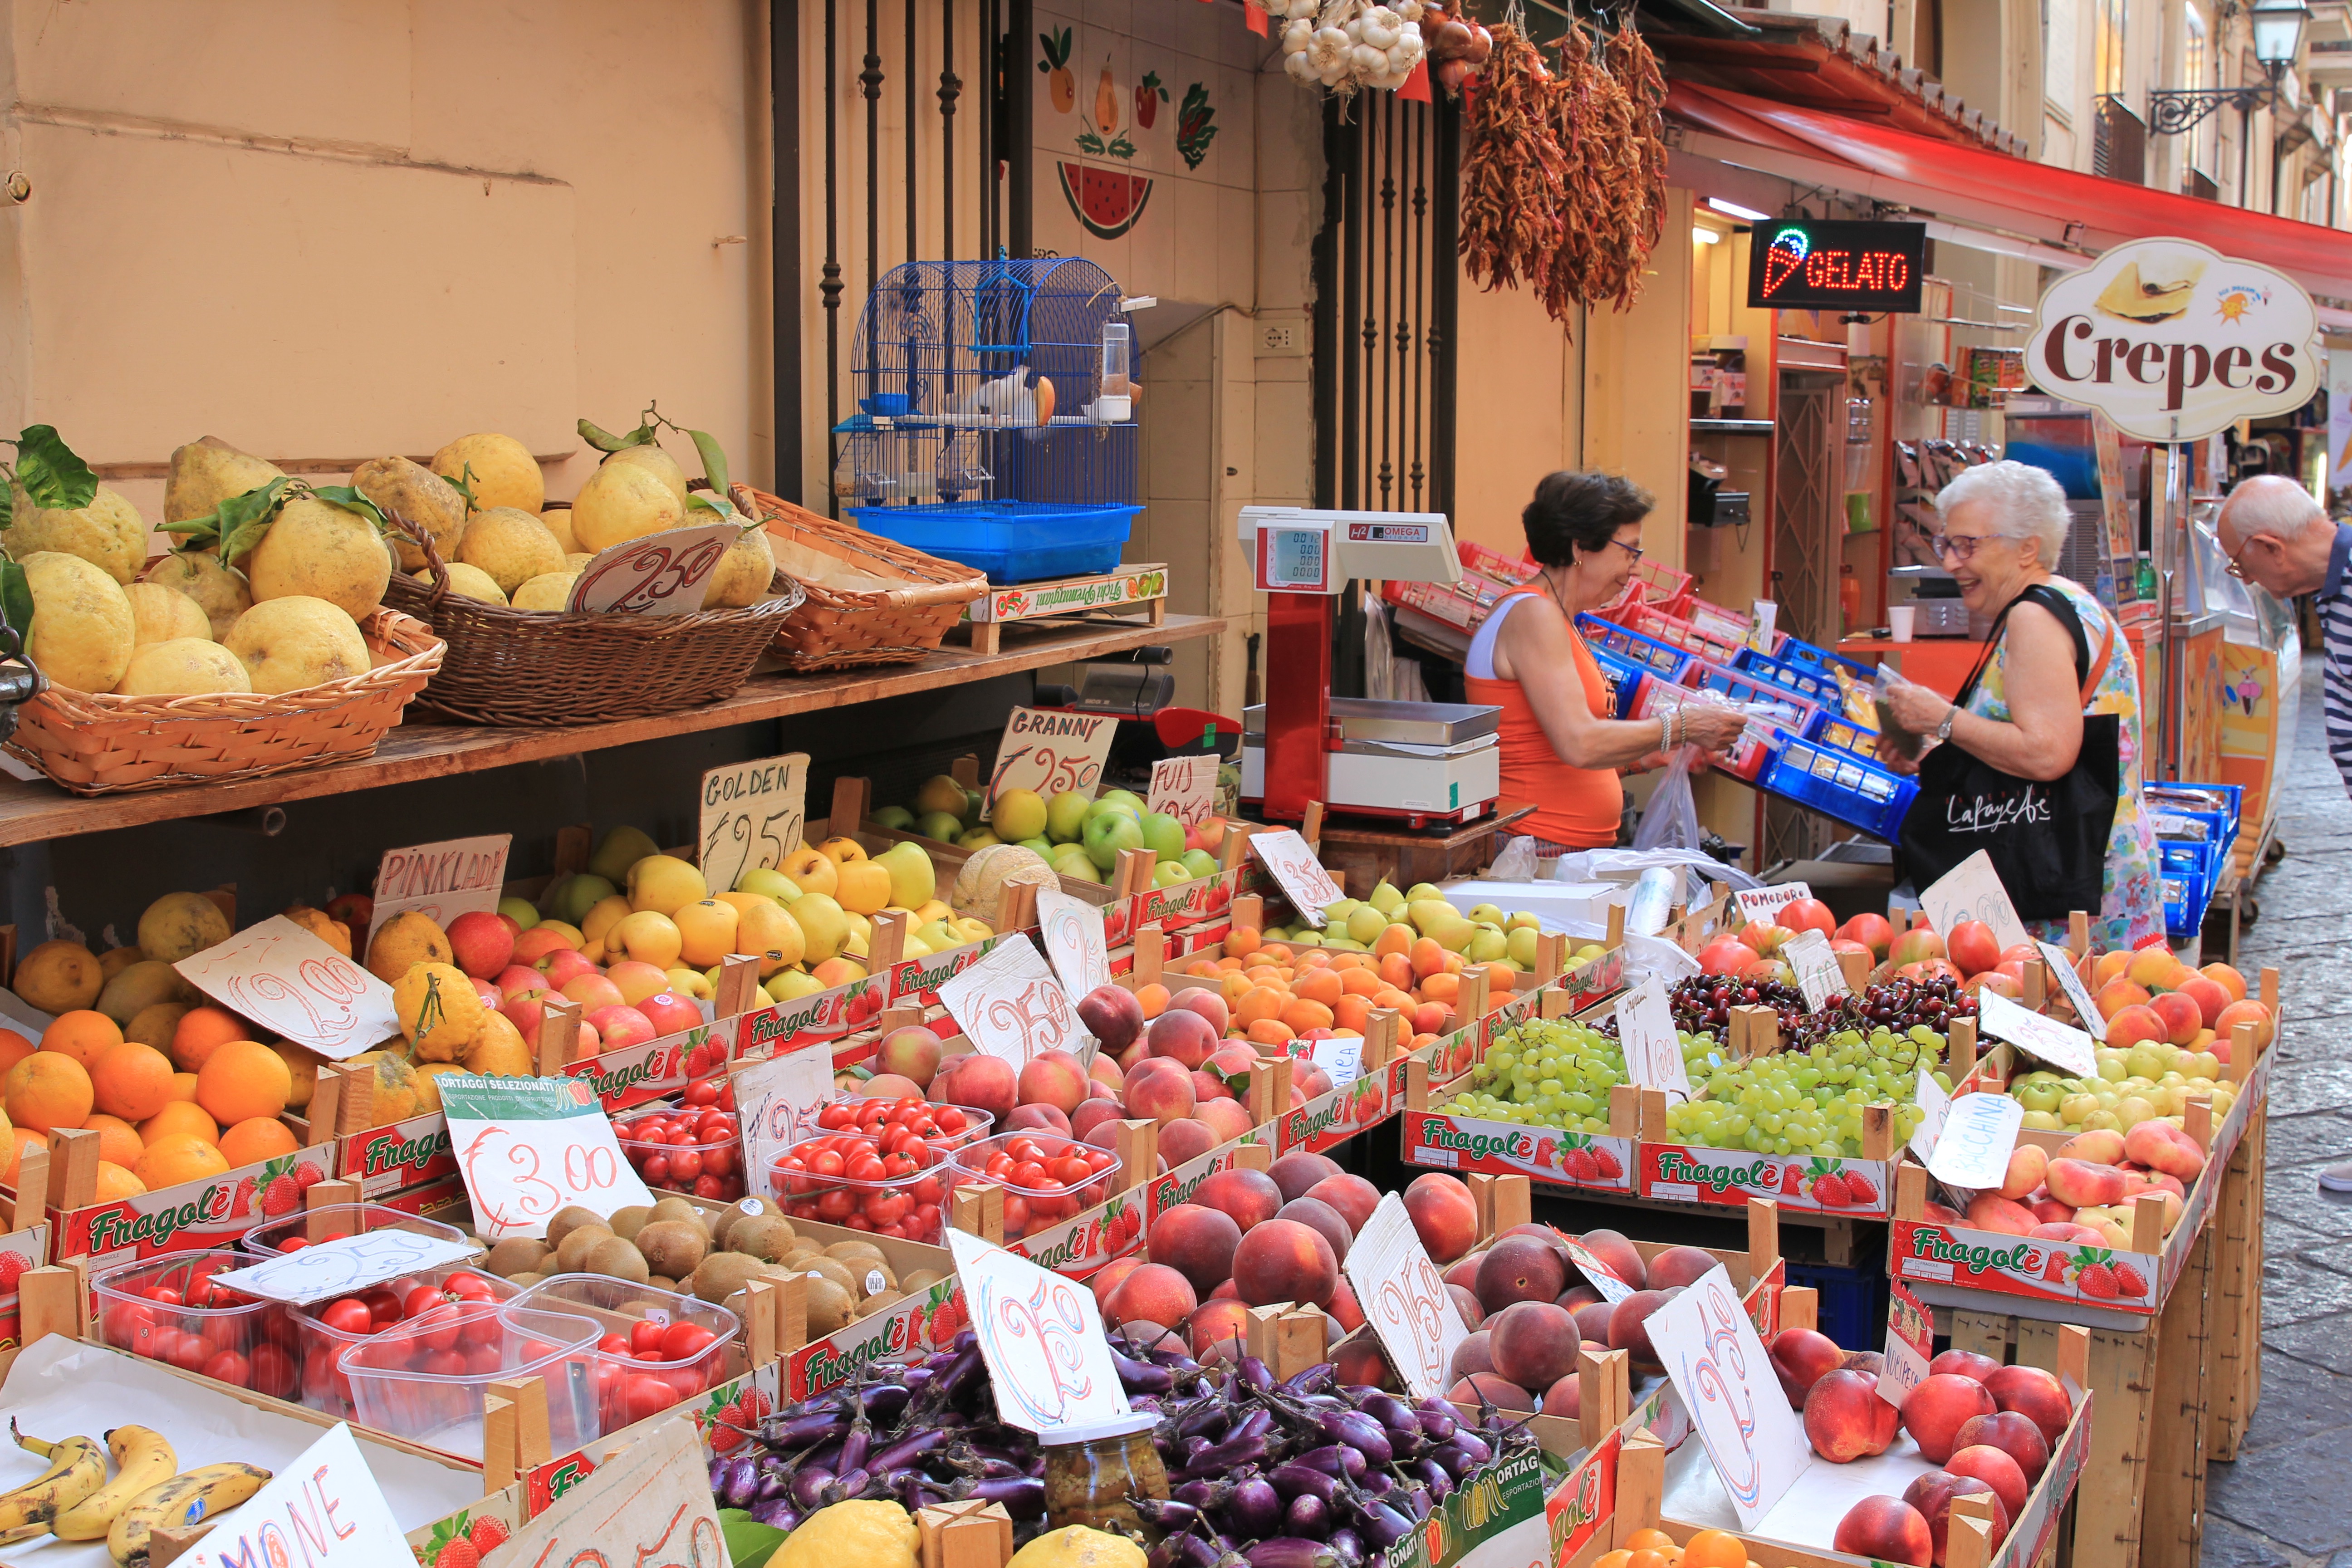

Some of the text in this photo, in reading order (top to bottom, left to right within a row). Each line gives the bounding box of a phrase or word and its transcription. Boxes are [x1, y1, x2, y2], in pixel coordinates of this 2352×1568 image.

[1805, 251, 1908, 291] GELATO
[2044, 315, 2297, 411] Crepes
[1385, 527, 1419, 536] OMEGA
[1096, 580, 1121, 603] Fichi
[1012, 710, 1103, 743] GRANNY
[705, 764, 790, 808] GOLDEN
[1147, 887, 1197, 922] Fragolè
[751, 997, 831, 1045] Fragolè
[441, 1077, 554, 1092] ORTAGGI SELEZIONATI
[448, 1093, 486, 1101] ESPORTAZIONE
[1289, 1096, 1343, 1145] Fragolè
[1422, 1118, 1534, 1160] Fragolè
[371, 1174, 389, 1183] FRAGOLE
[1657, 1151, 1780, 1193] Fragolè
[90, 1183, 230, 1254] Fragolè
[98, 1252, 120, 1262] FRAGOLE
[1913, 1227, 2043, 1275] Fragolè
